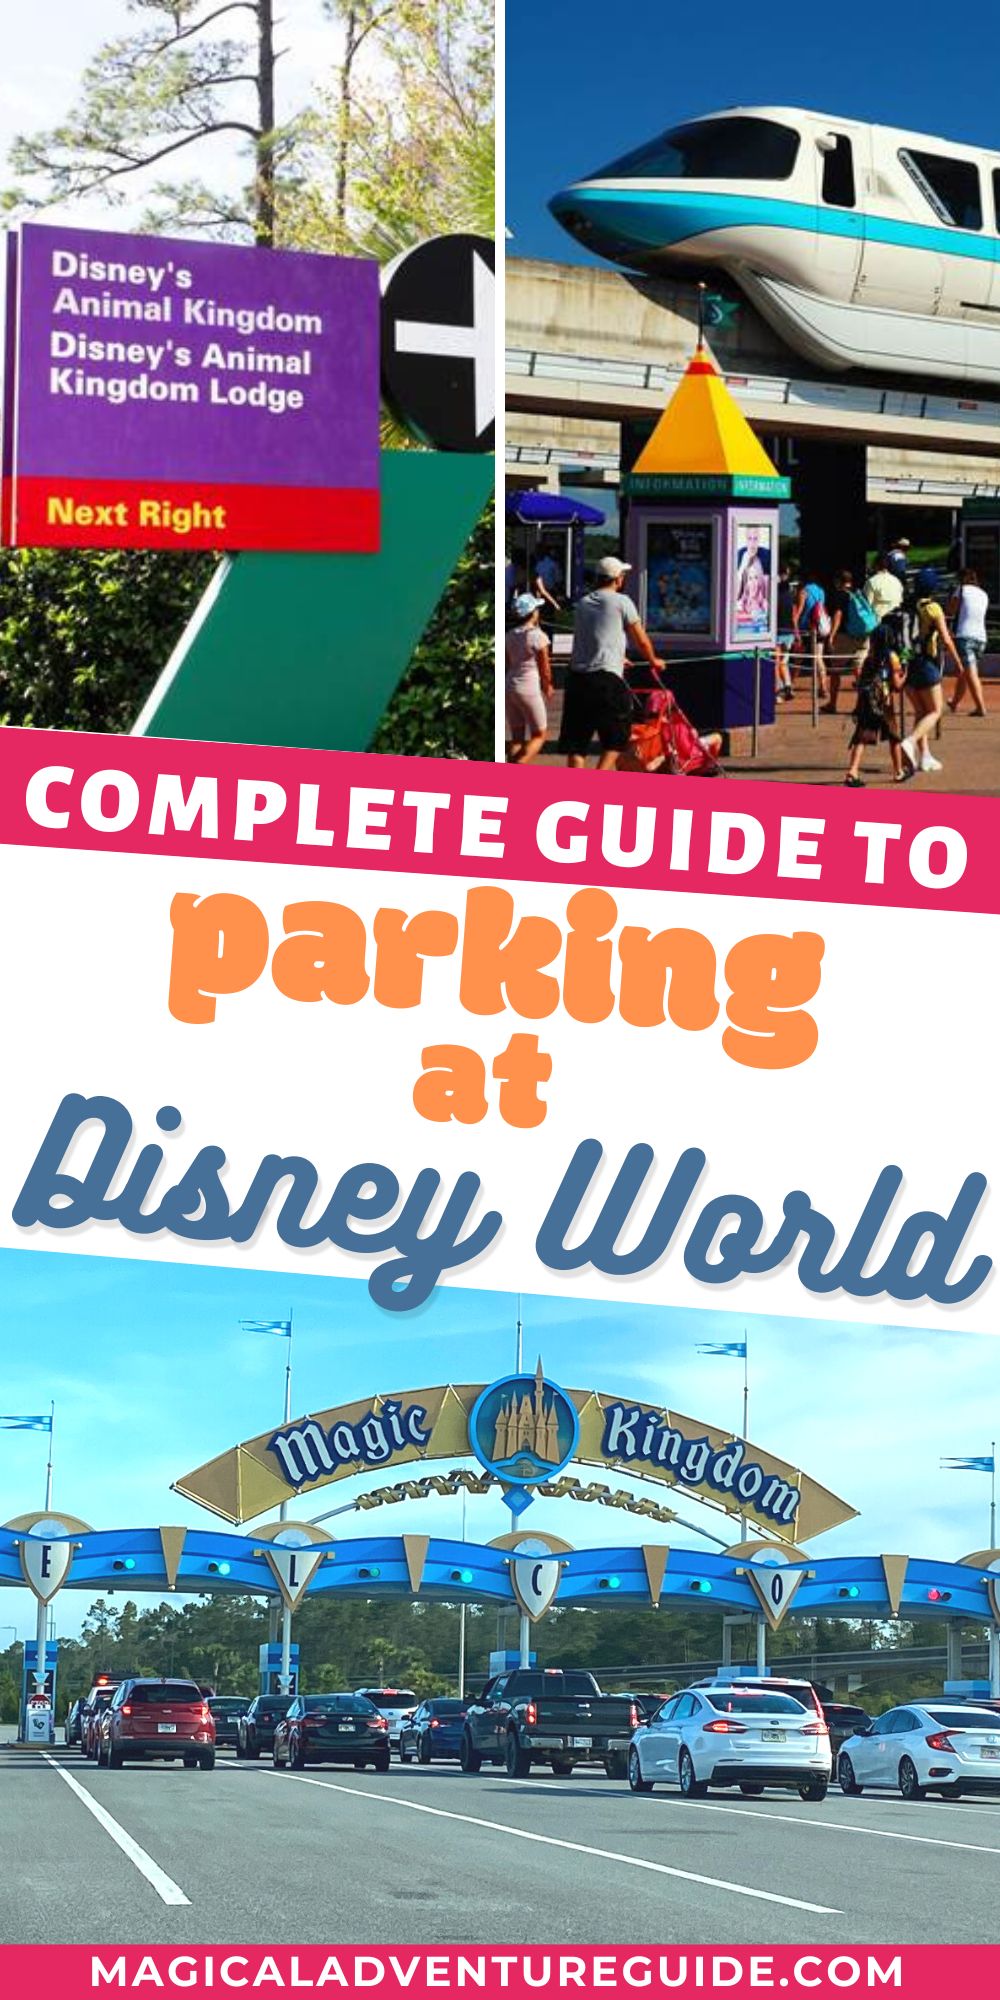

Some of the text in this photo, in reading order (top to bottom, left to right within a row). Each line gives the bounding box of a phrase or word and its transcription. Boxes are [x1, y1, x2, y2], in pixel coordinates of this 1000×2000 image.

[53, 251, 192, 291] Disney's
[54, 289, 322, 335] Animal Kingdom
[51, 331, 311, 375] Disney's Animal
[51, 368, 303, 413] Kingdom Lodge
[630, 477, 727, 490] INFORMATION
[49, 498, 225, 534] Next Right
[273, 1405, 428, 1482] Magic
[607, 1406, 800, 1521] Kingdom
[41, 1545, 52, 1578] E
[289, 1554, 299, 1587] L
[531, 1564, 543, 1596] C
